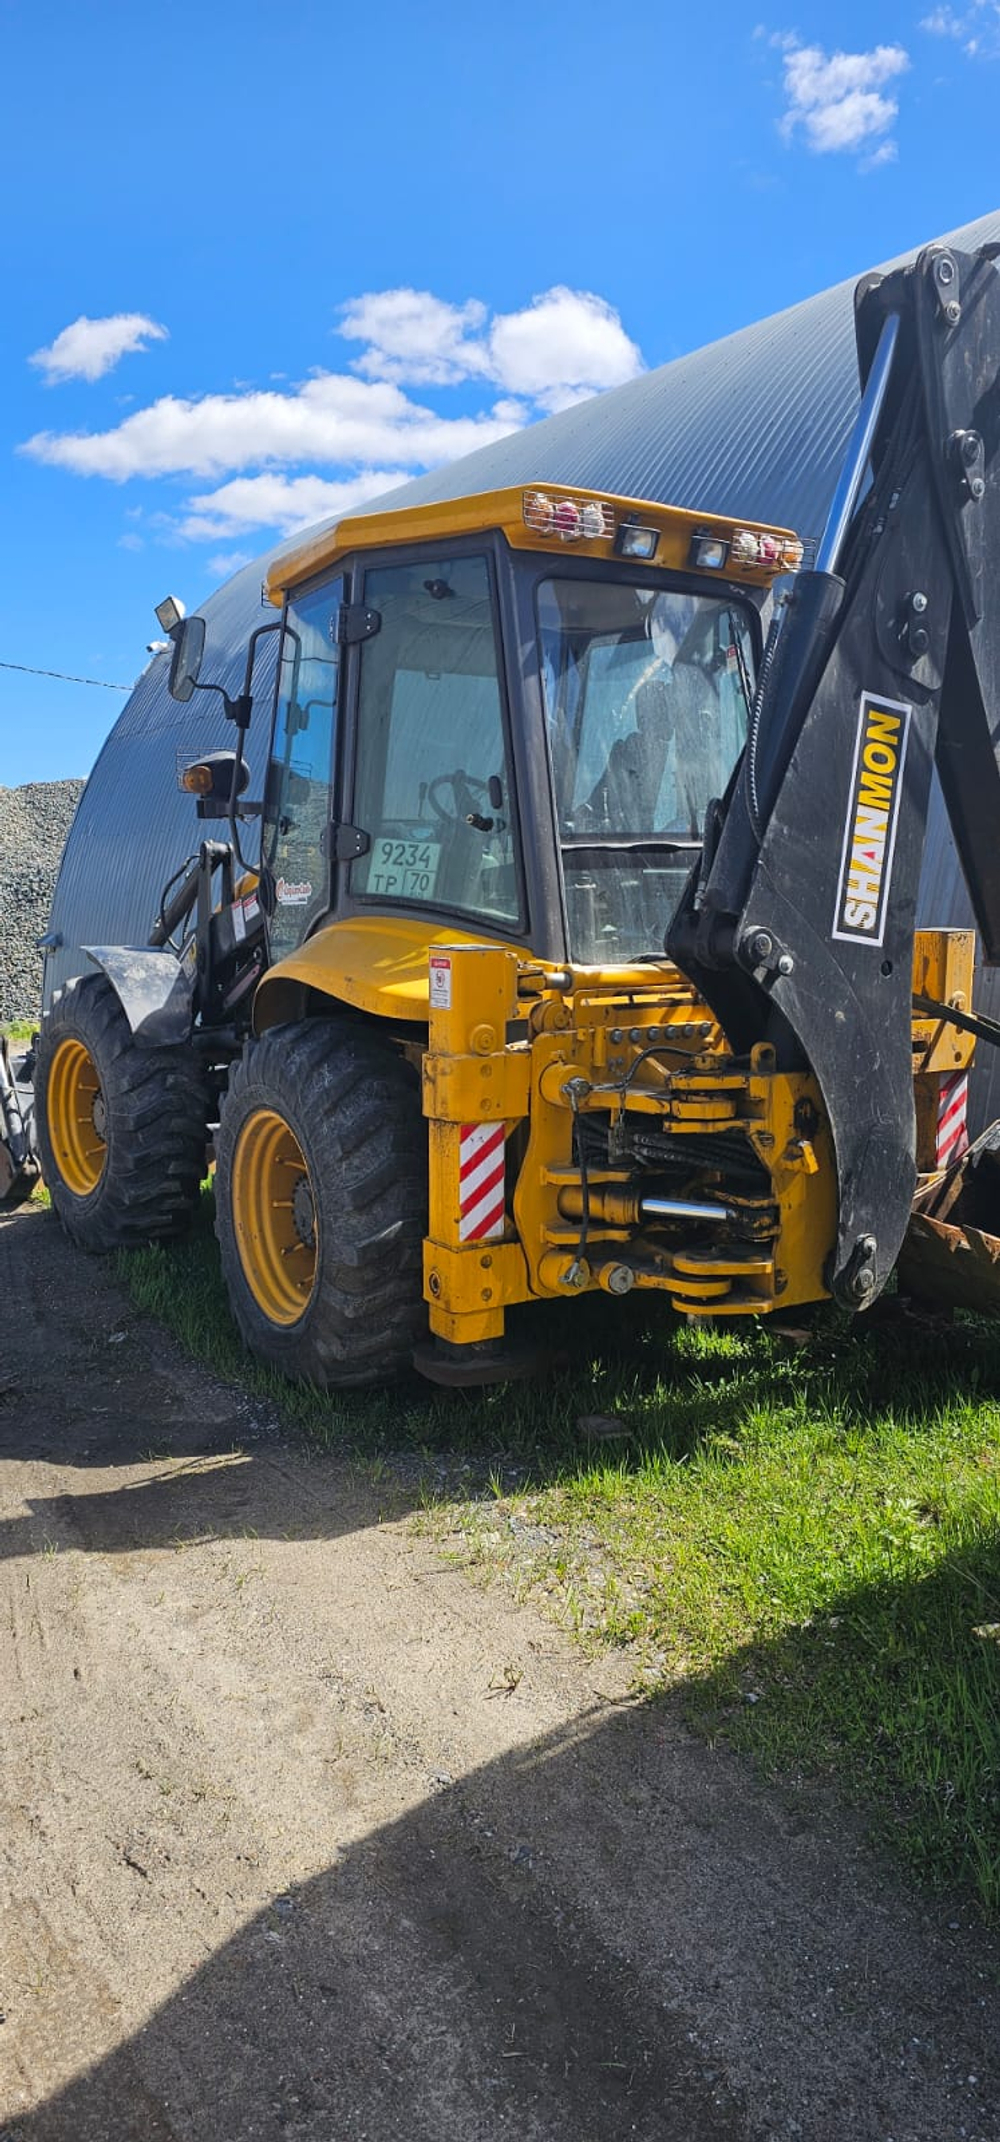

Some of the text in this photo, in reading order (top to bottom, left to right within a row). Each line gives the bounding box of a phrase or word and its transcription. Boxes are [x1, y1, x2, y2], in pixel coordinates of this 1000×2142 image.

[844, 709, 901, 930] SHANMON
[382, 842, 430, 868] 9234
[410, 872, 430, 891] 70
